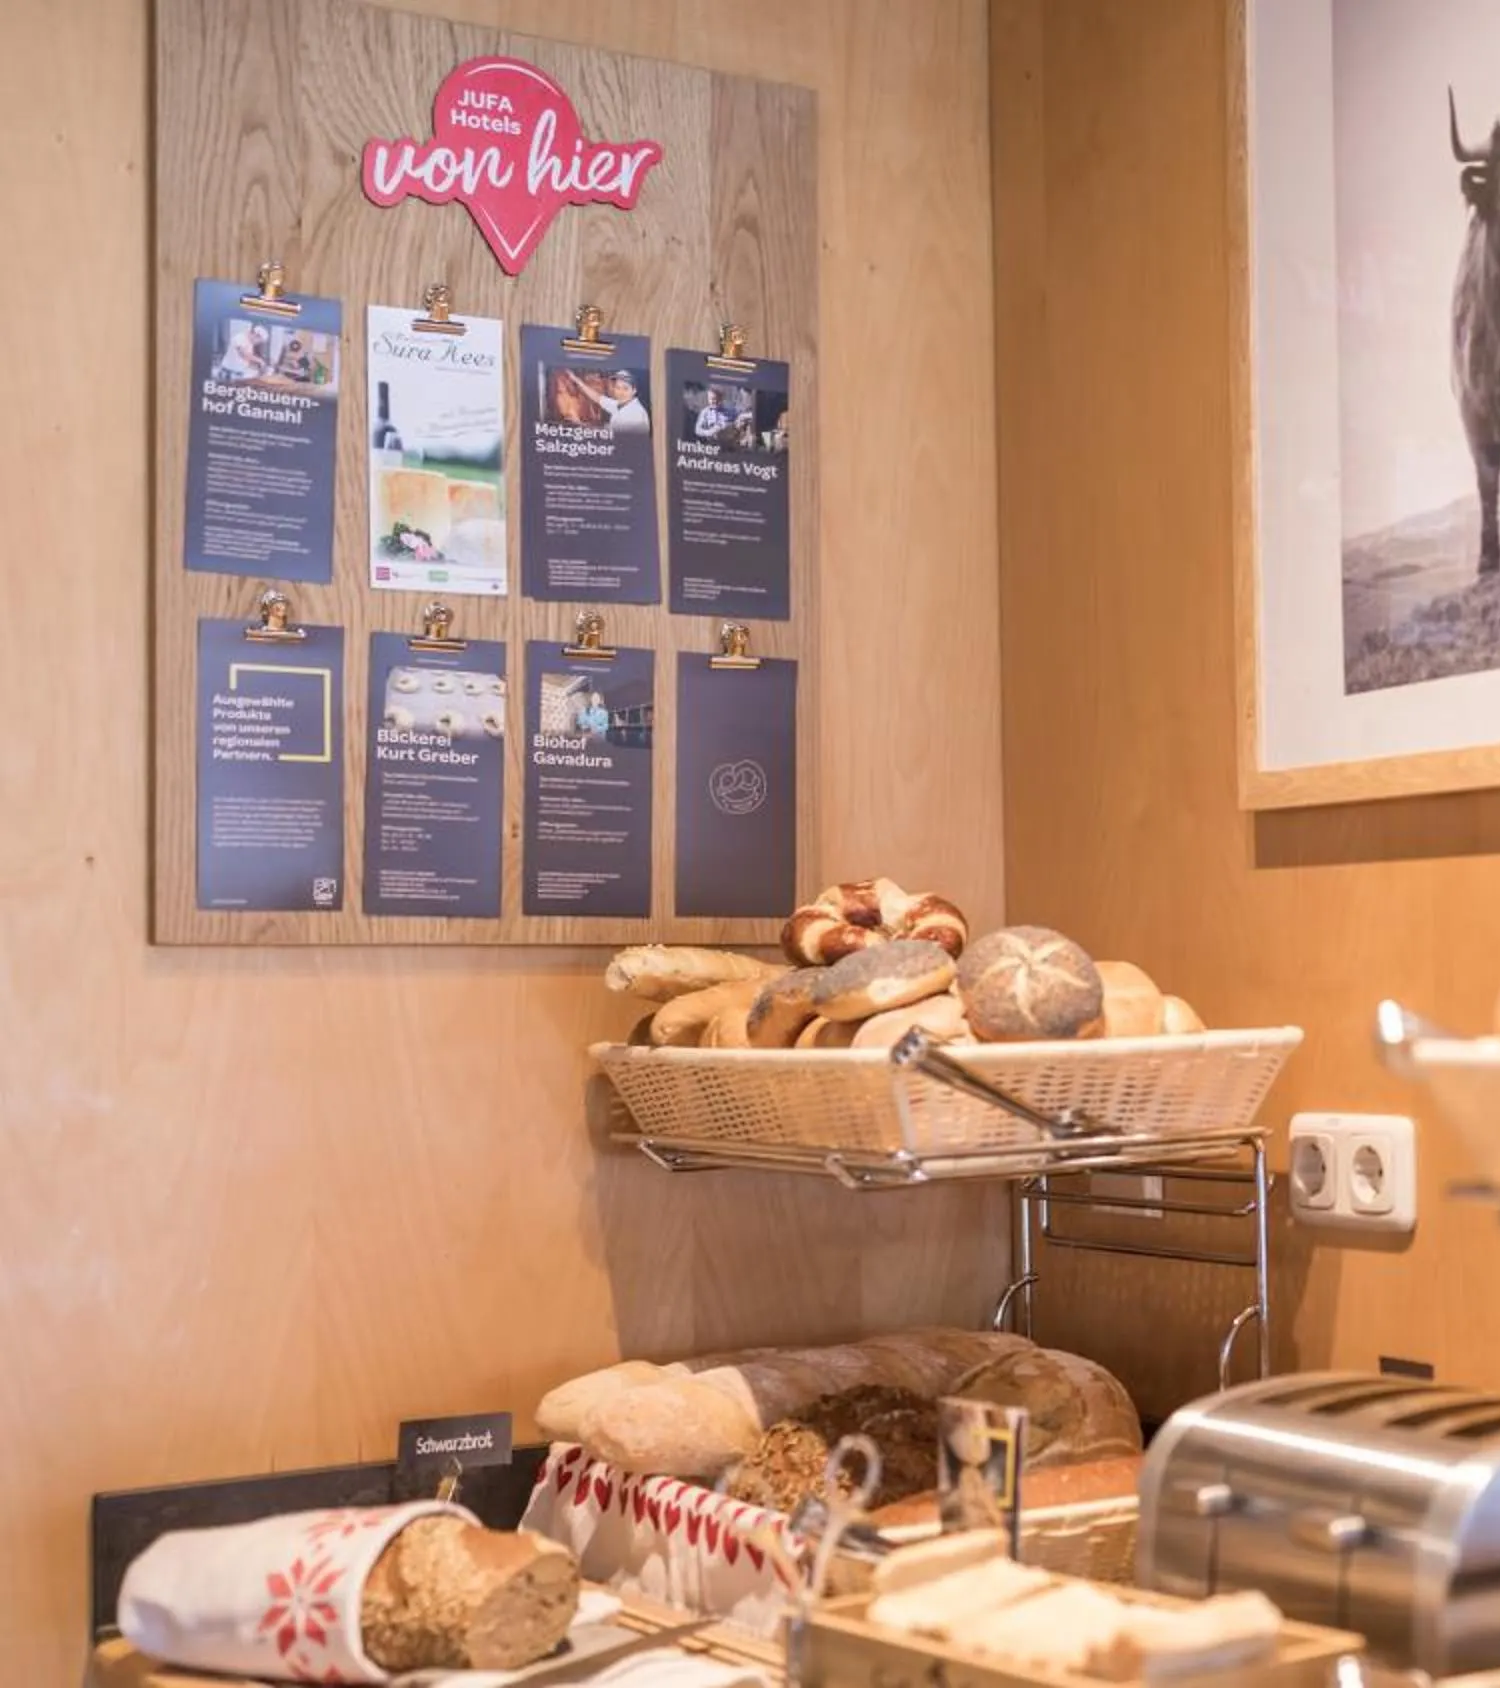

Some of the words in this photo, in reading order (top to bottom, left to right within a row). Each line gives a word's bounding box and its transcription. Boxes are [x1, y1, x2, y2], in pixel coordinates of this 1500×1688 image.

[457, 88, 513, 113] JUFA
[450, 109, 522, 136] Hotels
[373, 144, 515, 195] von
[527, 108, 655, 198] hier
[203, 380, 320, 409] Bergbauern-
[202, 397, 235, 415] hof
[237, 403, 302, 424] Ganahl
[535, 423, 614, 441] Metzgerei
[535, 439, 615, 457] Salzgeber
[677, 438, 721, 455] Imker
[677, 455, 740, 474] Andreas
[743, 461, 778, 480] Vogt
[377, 728, 451, 746] Bäckerei
[533, 734, 587, 750] Biohof
[377, 745, 416, 760] Kurt
[418, 748, 478, 765] Greber
[533, 751, 613, 768] Gavadura
[415, 1430, 493, 1455] Schwarzbrot
